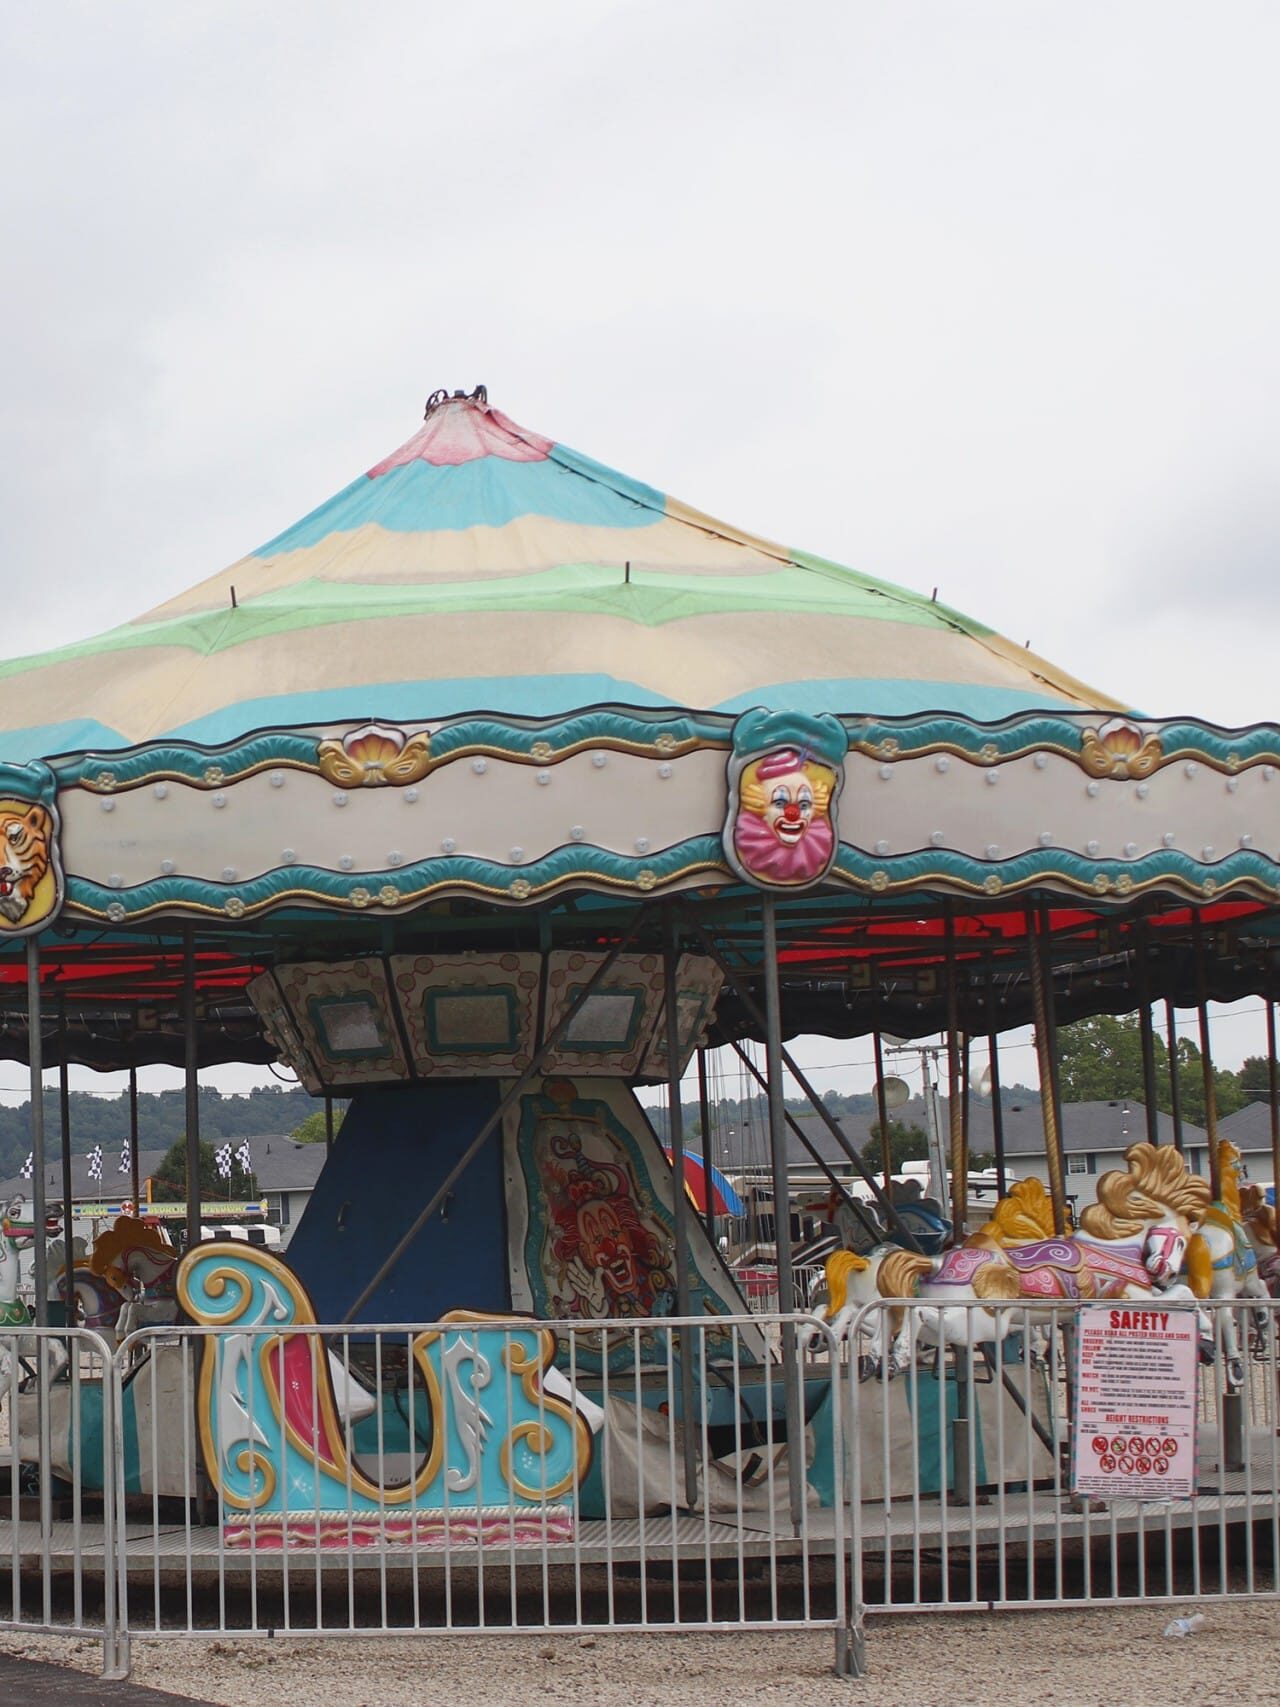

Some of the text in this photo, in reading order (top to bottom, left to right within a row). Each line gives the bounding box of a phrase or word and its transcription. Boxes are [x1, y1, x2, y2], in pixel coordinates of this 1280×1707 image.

[1110, 1310, 1169, 1331] SAFETY
[1106, 1414, 1169, 1424] HEIGHT RESTRICTIONS
